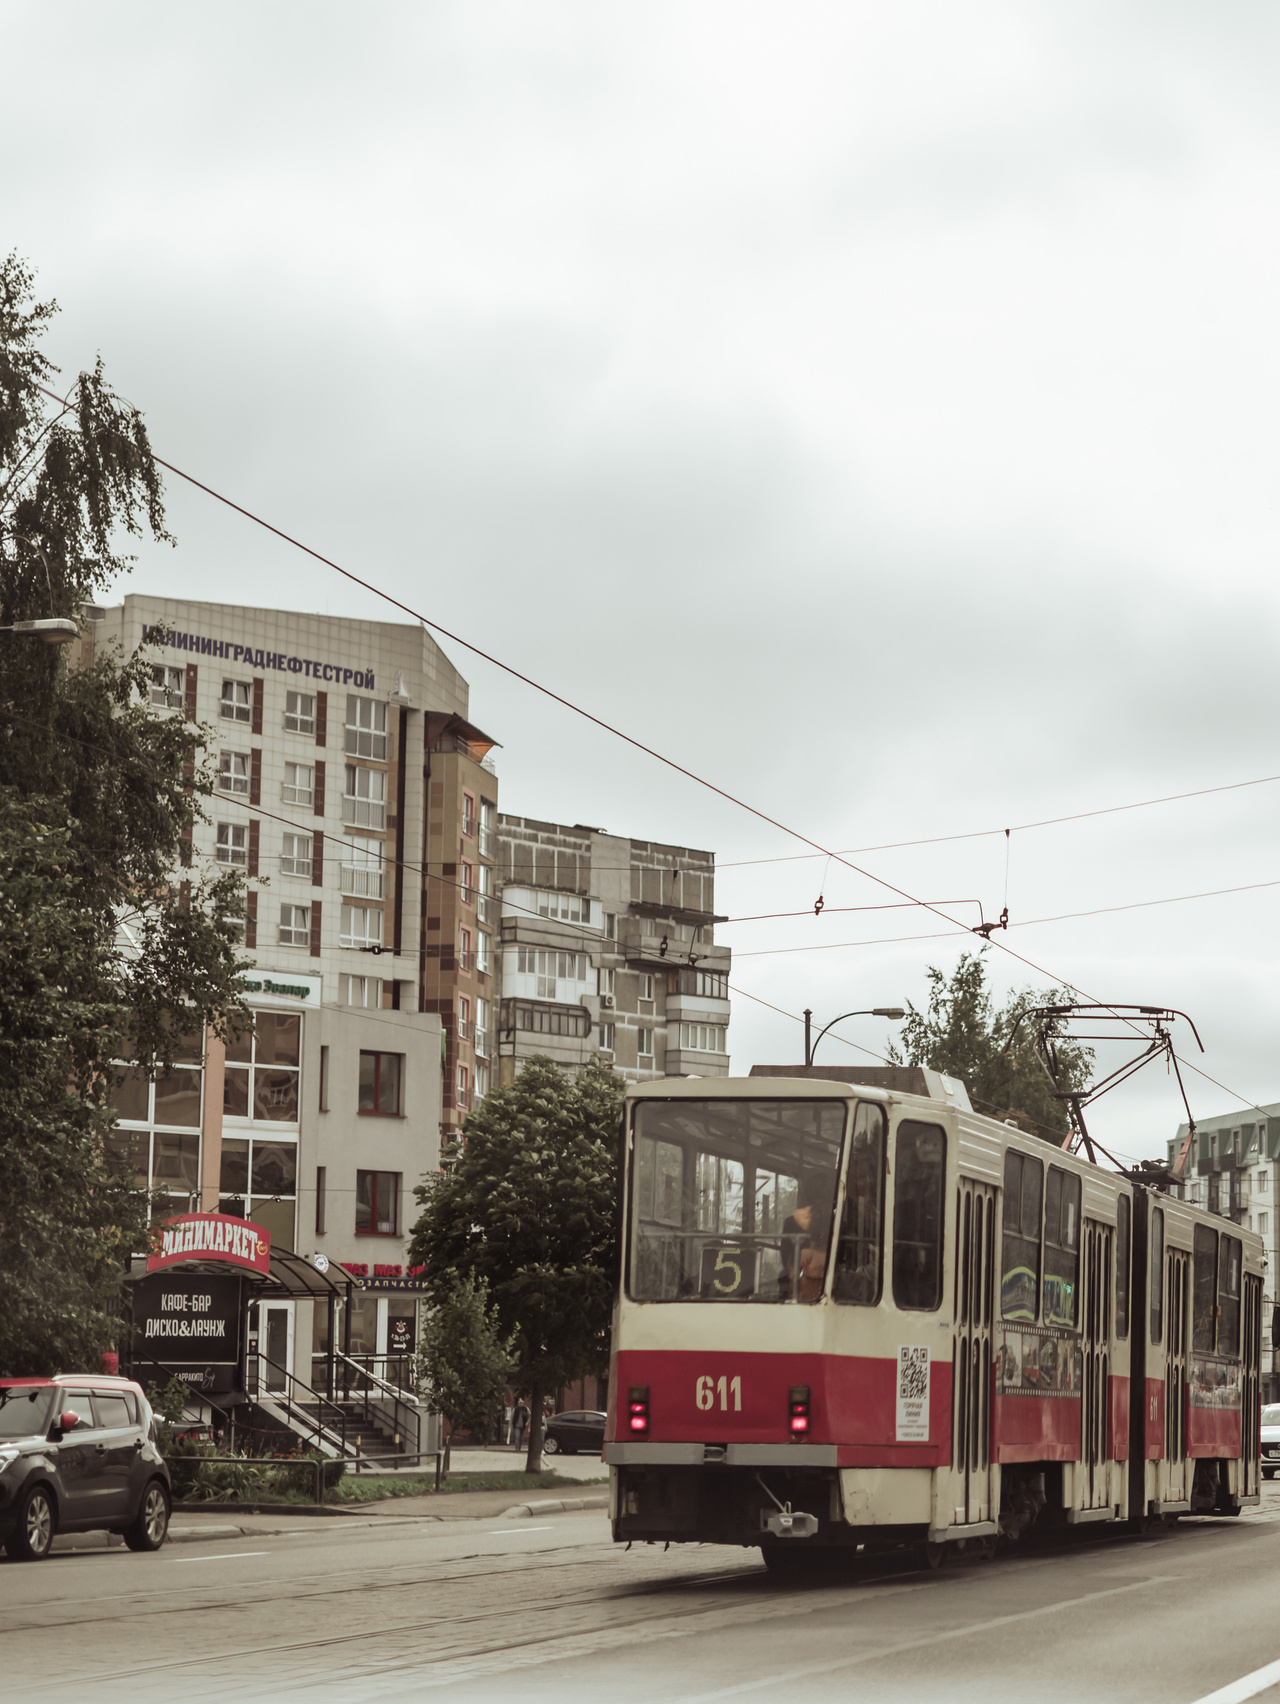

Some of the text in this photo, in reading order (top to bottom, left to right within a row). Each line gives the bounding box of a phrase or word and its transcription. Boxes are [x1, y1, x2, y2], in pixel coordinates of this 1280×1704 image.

[142, 624, 375, 690] КЛИНИНГРАДНЕФТЕСТРОЙ
[161, 1220, 258, 1262] МИНИМАРКЕТ
[374, 1264, 402, 1277] МАЗ
[714, 1248, 741, 1293] 5
[161, 1294, 212, 1312] КАФЕ-БАР
[145, 1318, 226, 1338] ДИСКО&ЛАУНЖ
[696, 1376, 742, 1411] 611
